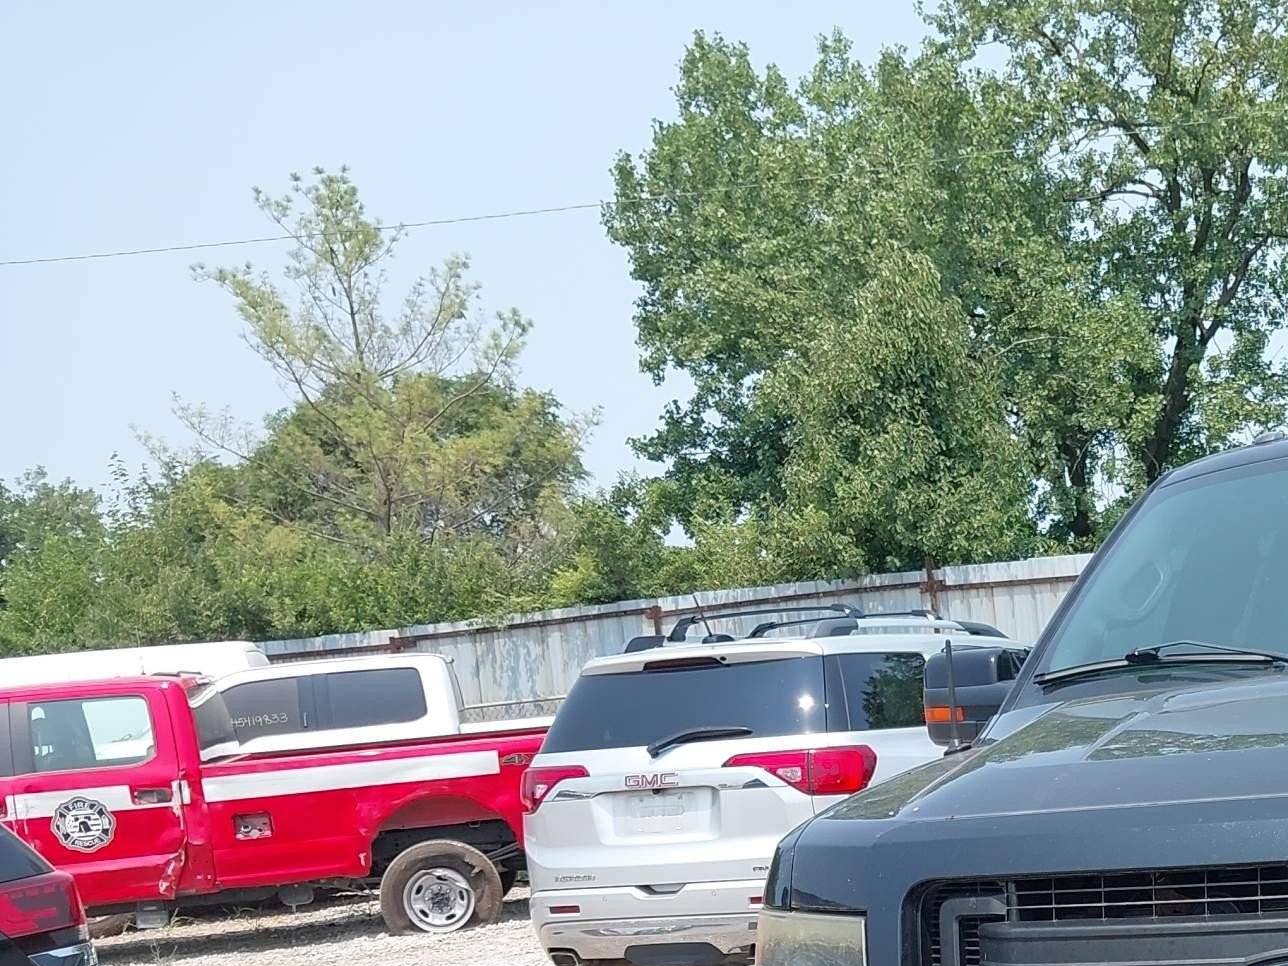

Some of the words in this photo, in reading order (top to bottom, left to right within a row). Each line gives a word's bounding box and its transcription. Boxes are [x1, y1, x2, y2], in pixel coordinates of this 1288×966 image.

[624, 772, 679, 789] GMC
[68, 801, 90, 811] FIRE
[74, 837, 102, 847] RESCUE
